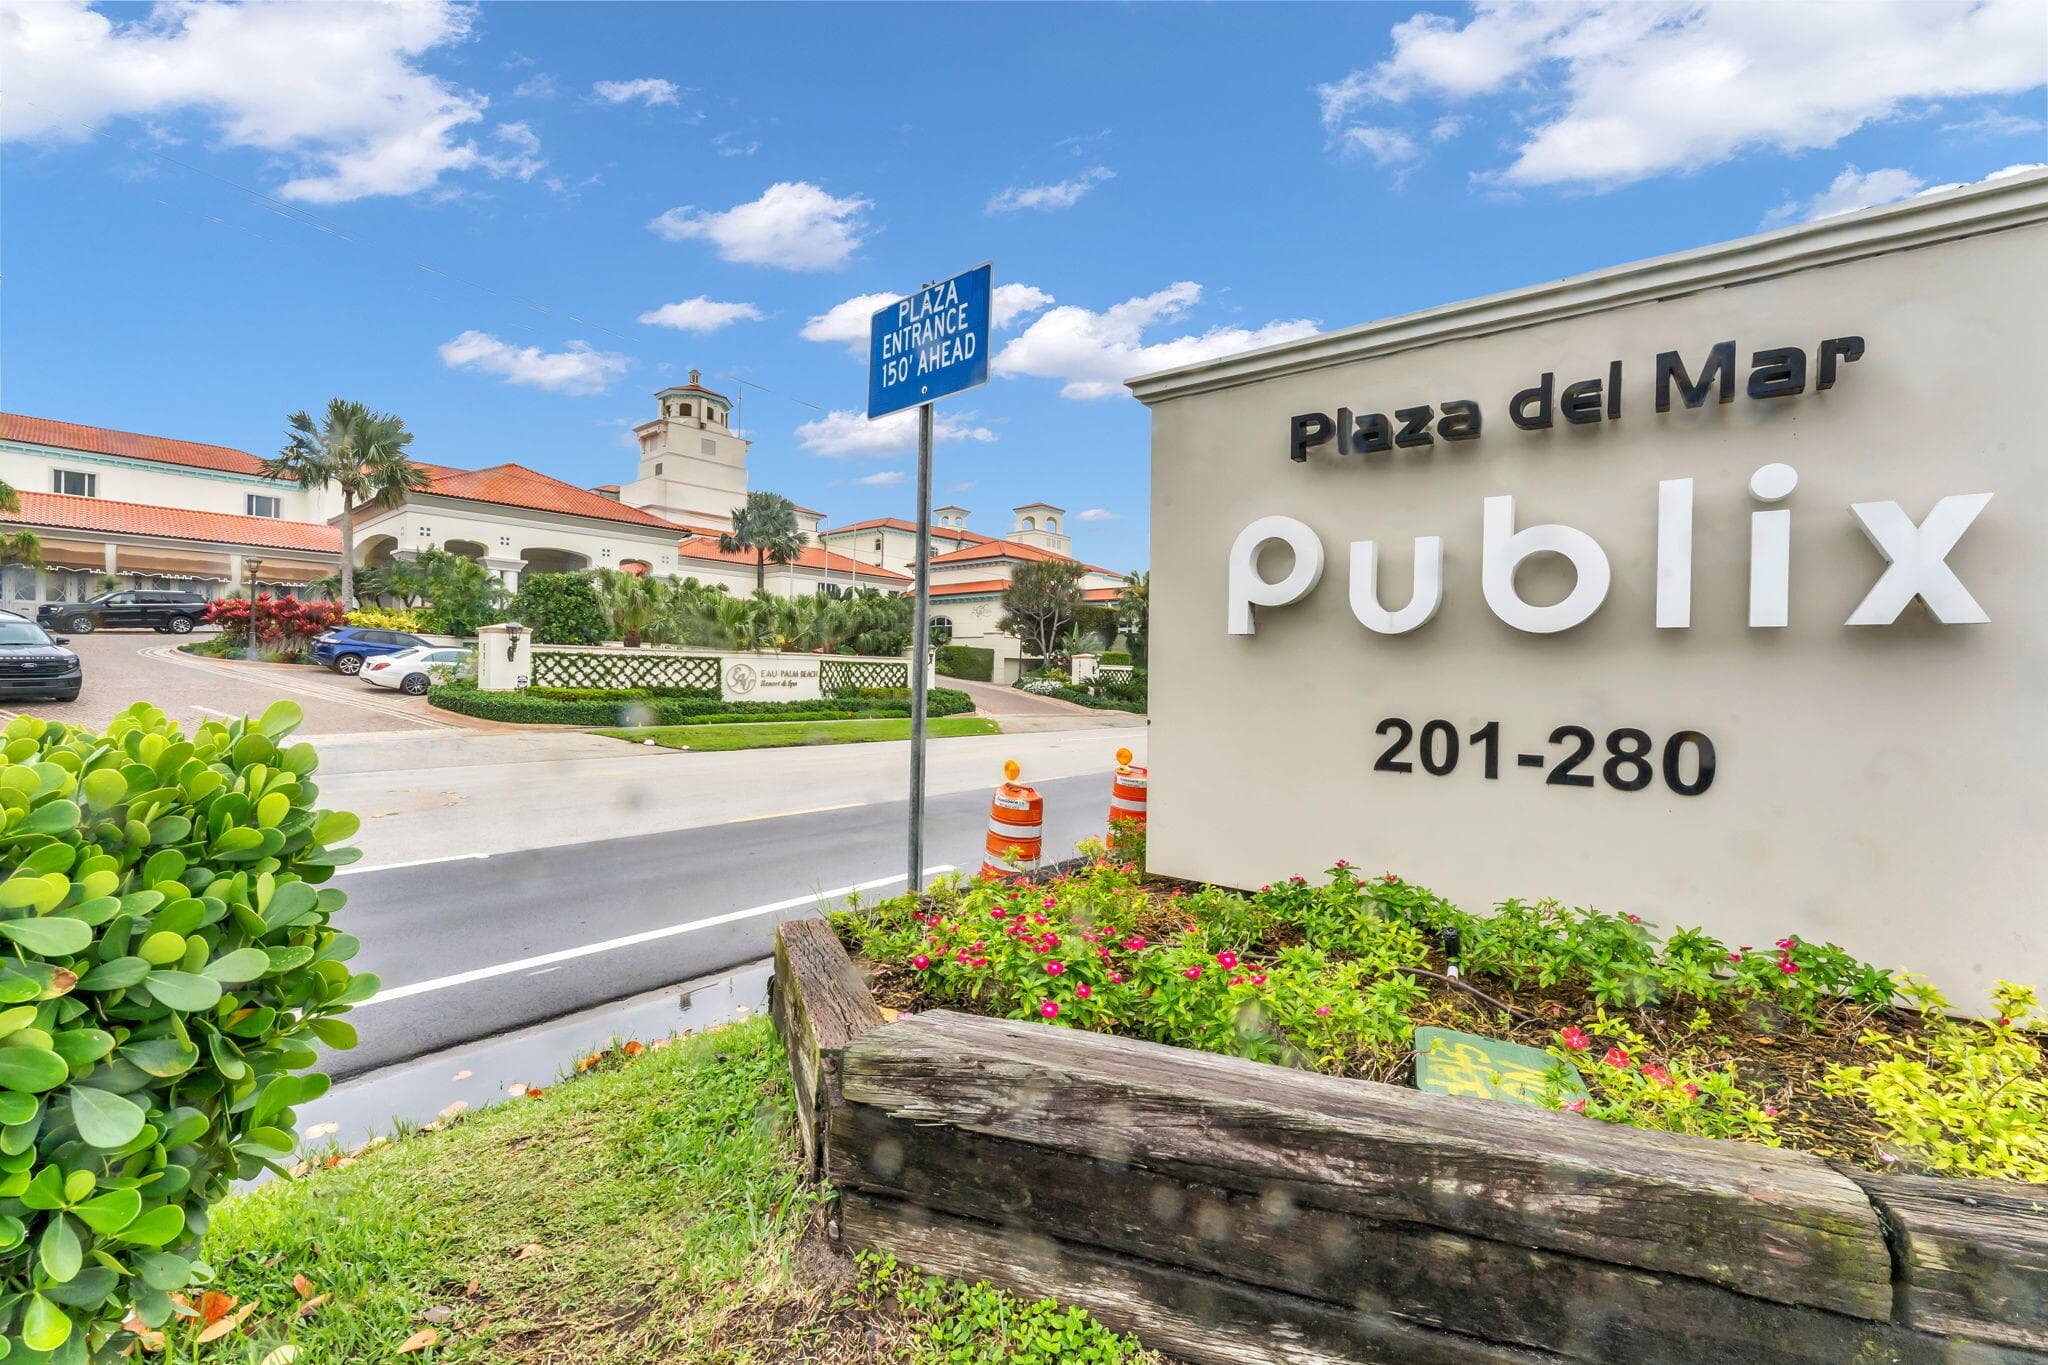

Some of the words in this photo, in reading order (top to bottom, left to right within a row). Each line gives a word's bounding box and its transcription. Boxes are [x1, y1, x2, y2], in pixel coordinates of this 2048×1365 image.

[898, 280, 958, 328] PLAZA
[883, 302, 968, 359] ENTRANCE
[917, 332, 976, 376] AHEAD
[1290, 400, 1482, 463] Plaza
[1508, 360, 1623, 432] del
[1655, 335, 1865, 413] Mar
[760, 670, 778, 678] EAU
[780, 670, 799, 678] PALM
[800, 670, 818, 678] BEACH
[1373, 717, 1716, 796] 201-280
